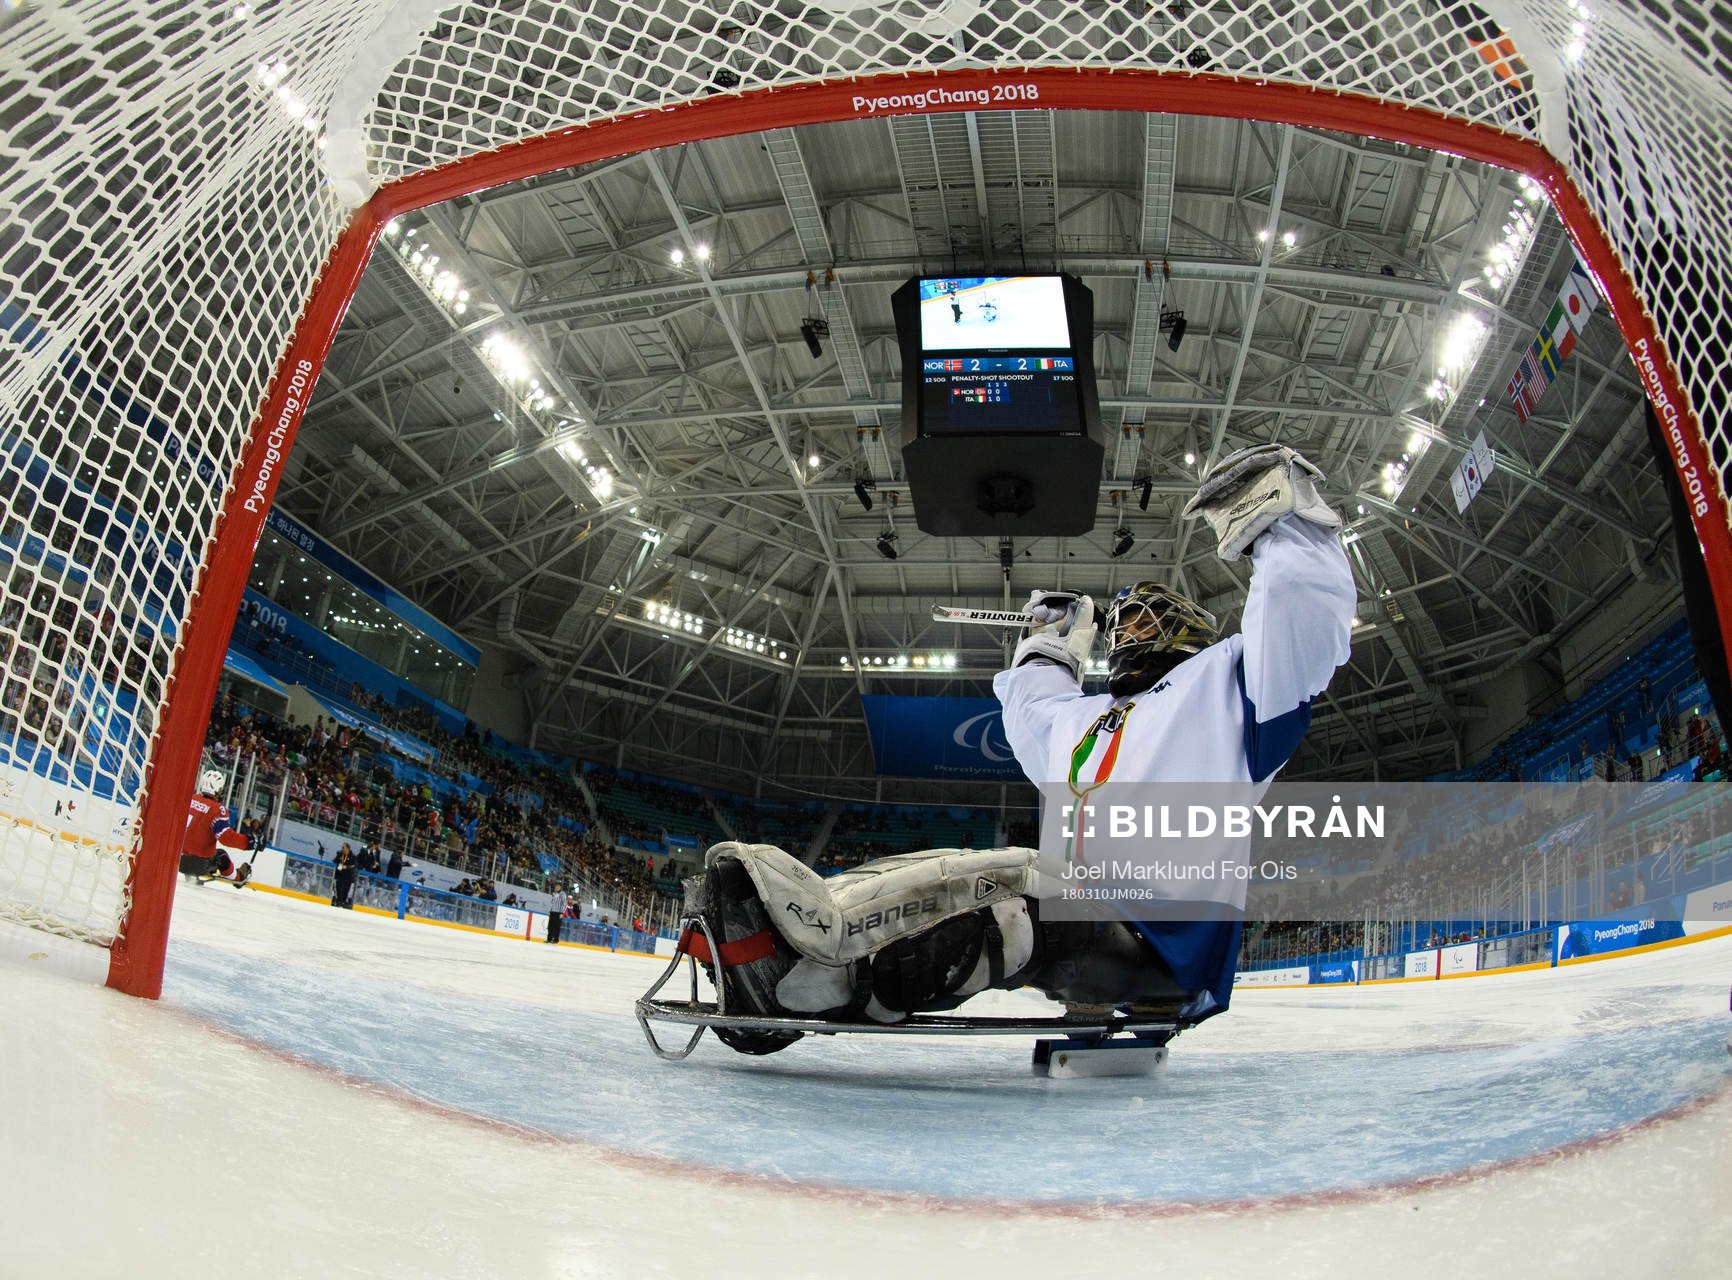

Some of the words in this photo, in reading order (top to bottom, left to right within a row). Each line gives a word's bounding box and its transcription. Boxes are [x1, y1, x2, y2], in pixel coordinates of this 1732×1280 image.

[852, 88, 989, 112] PyeongChang
[992, 84, 1039, 101] 2018
[924, 362, 944, 370] NOR
[970, 359, 981, 371] 2
[1018, 359, 1028, 370] 2
[1053, 360, 1068, 368] ITA
[243, 397, 300, 513] PyeongChang
[288, 359, 313, 398] 2018
[1635, 337, 1691, 468] PyeongChang
[1684, 466, 1710, 518] 2018
[970, 611, 1034, 623] FRONTIER
[934, 765, 1019, 776] Paralympic
[504, 918, 520, 930] 2018
[1594, 925, 1639, 942] PyeongChang
[1638, 918, 1656, 931] 2018
